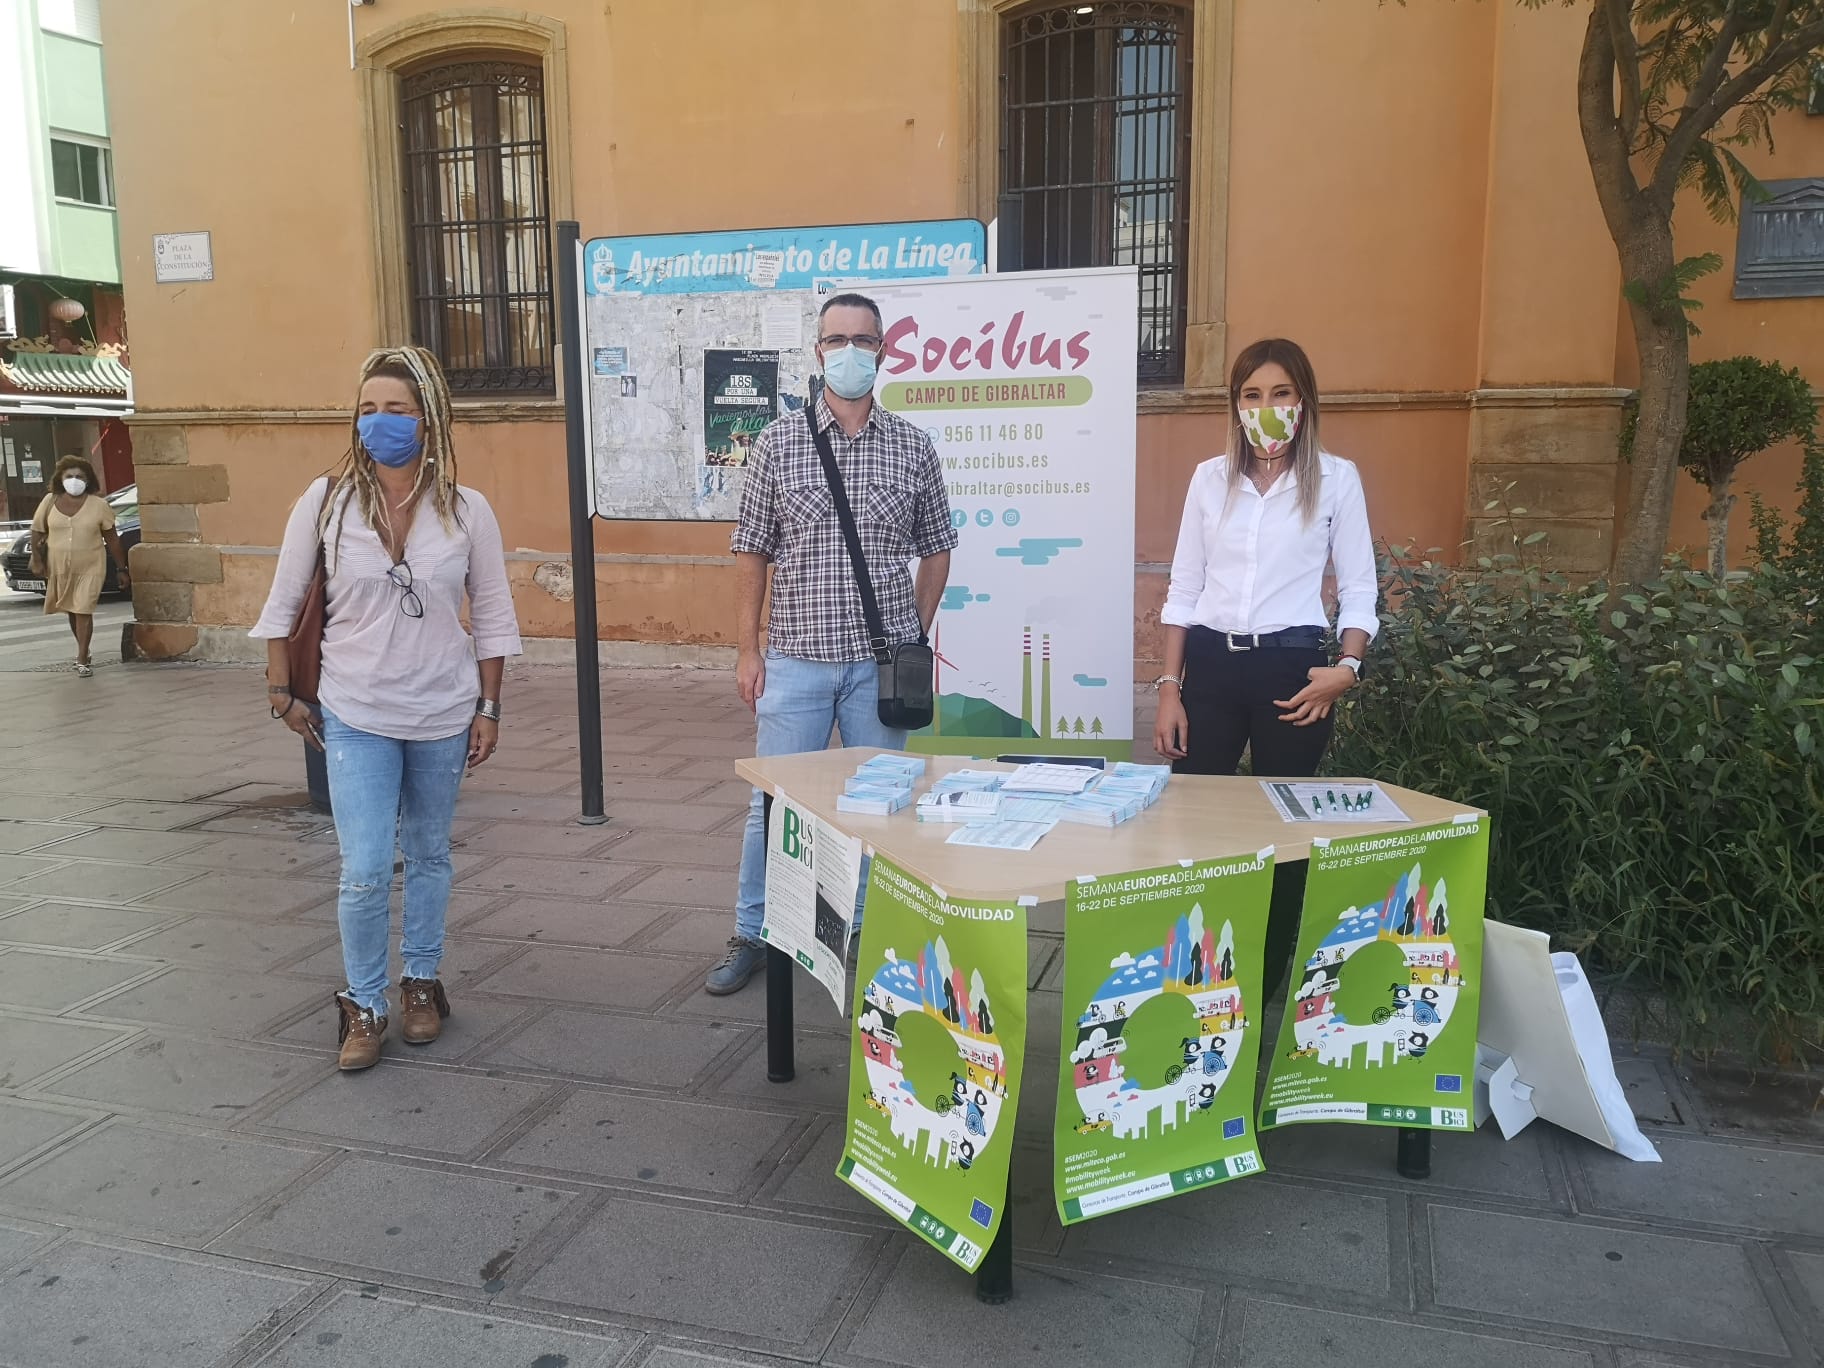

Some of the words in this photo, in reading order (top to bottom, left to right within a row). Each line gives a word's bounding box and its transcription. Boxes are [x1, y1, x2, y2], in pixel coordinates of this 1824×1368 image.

[171, 244, 192, 252] PLAZA
[627, 243, 813, 287] Ayuntamito
[818, 239, 852, 271] de
[857, 239, 889, 270] La
[894, 235, 973, 269] Línea
[731, 375, 752, 388] 18S
[905, 386, 956, 405] CAMPO
[961, 385, 980, 402] DE
[985, 382, 1067, 402] GIBRALTAR
[943, 425, 974, 443] 956
[979, 425, 993, 442] 11
[998, 424, 1018, 441] 46
[1024, 423, 1044, 441] 80
[944, 479, 1091, 498] gibraltar@socibus.es
[1318, 860, 1339, 871] 16-22
[1340, 857, 1352, 868] DE
[1354, 848, 1407, 866] SEPTIEMBRE
[1409, 845, 1427, 856] 2020
[885, 883, 893, 895] DE
[893, 889, 928, 918] SEPTIEMBRE
[928, 912, 945, 926] 2020
[1075, 900, 1101, 913] 16-22
[1103, 898, 1117, 908] DE
[1119, 886, 1182, 906] SEPTIEMBRE
[1184, 883, 1205, 895] 2020
